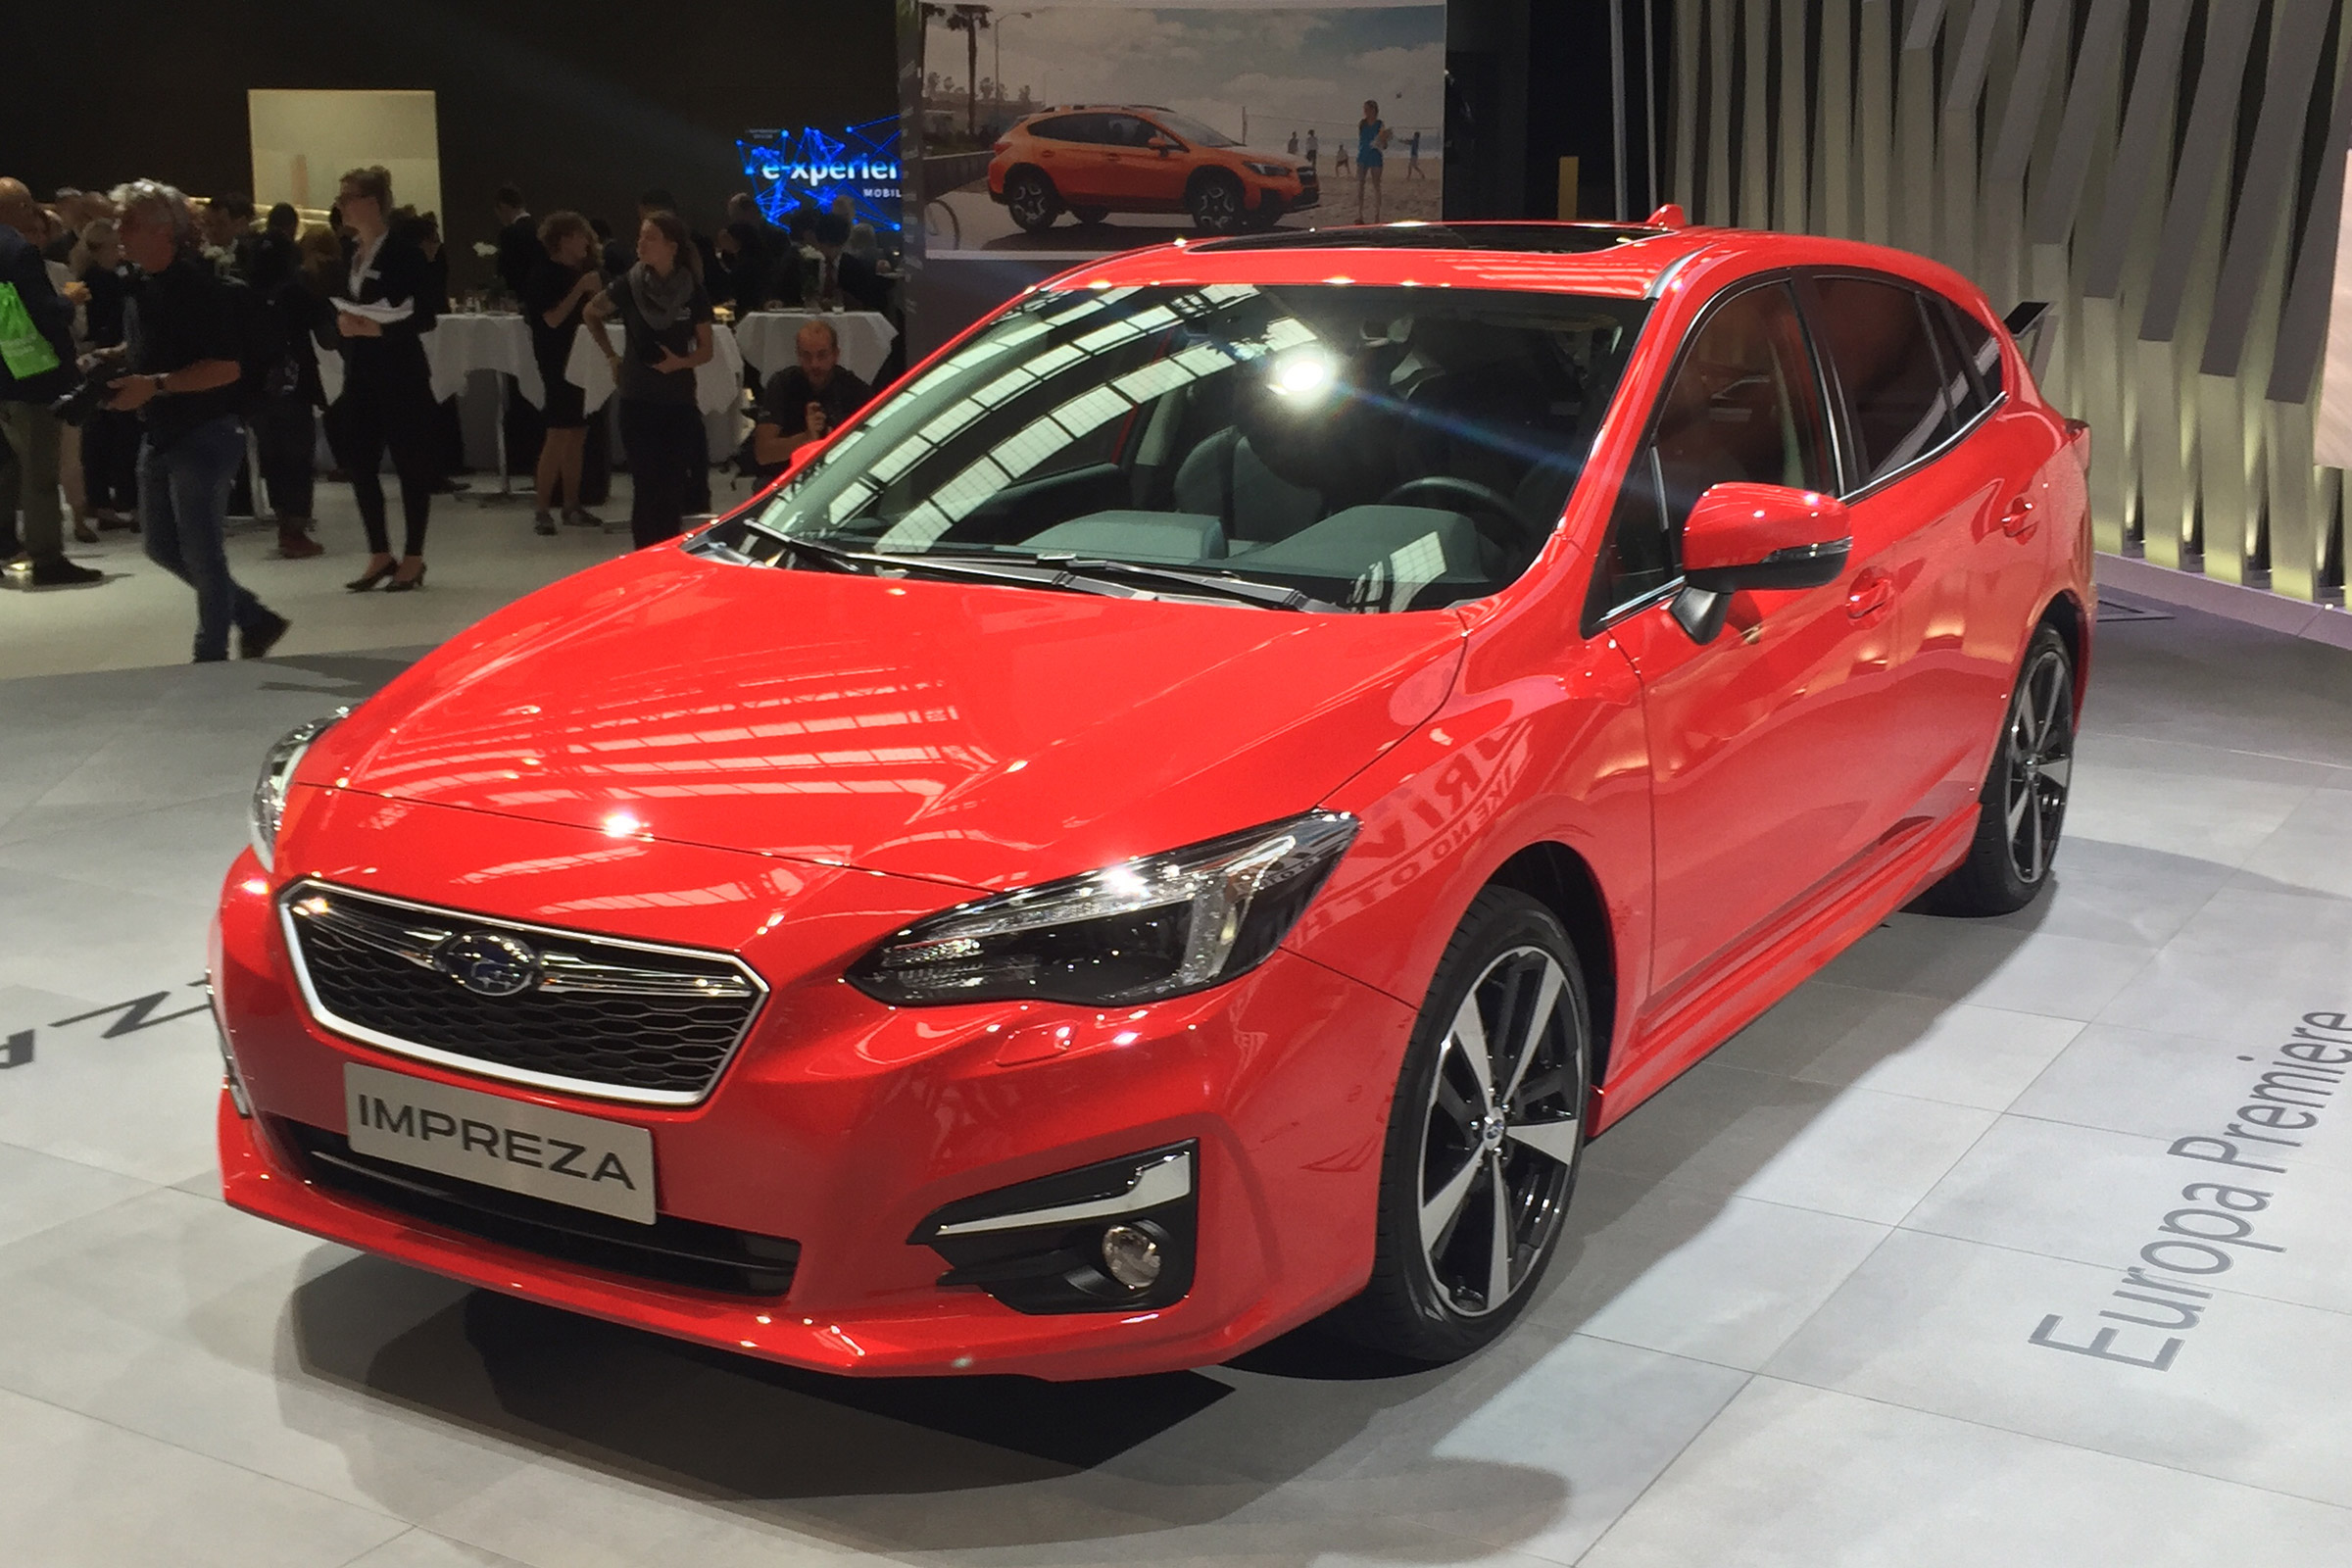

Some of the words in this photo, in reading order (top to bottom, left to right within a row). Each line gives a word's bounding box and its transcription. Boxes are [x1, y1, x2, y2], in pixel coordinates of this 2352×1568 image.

[358, 1093, 637, 1192] IMPREZA
[2028, 1182, 2287, 1372] Europa
[2166, 1011, 2352, 1174] Premiere
